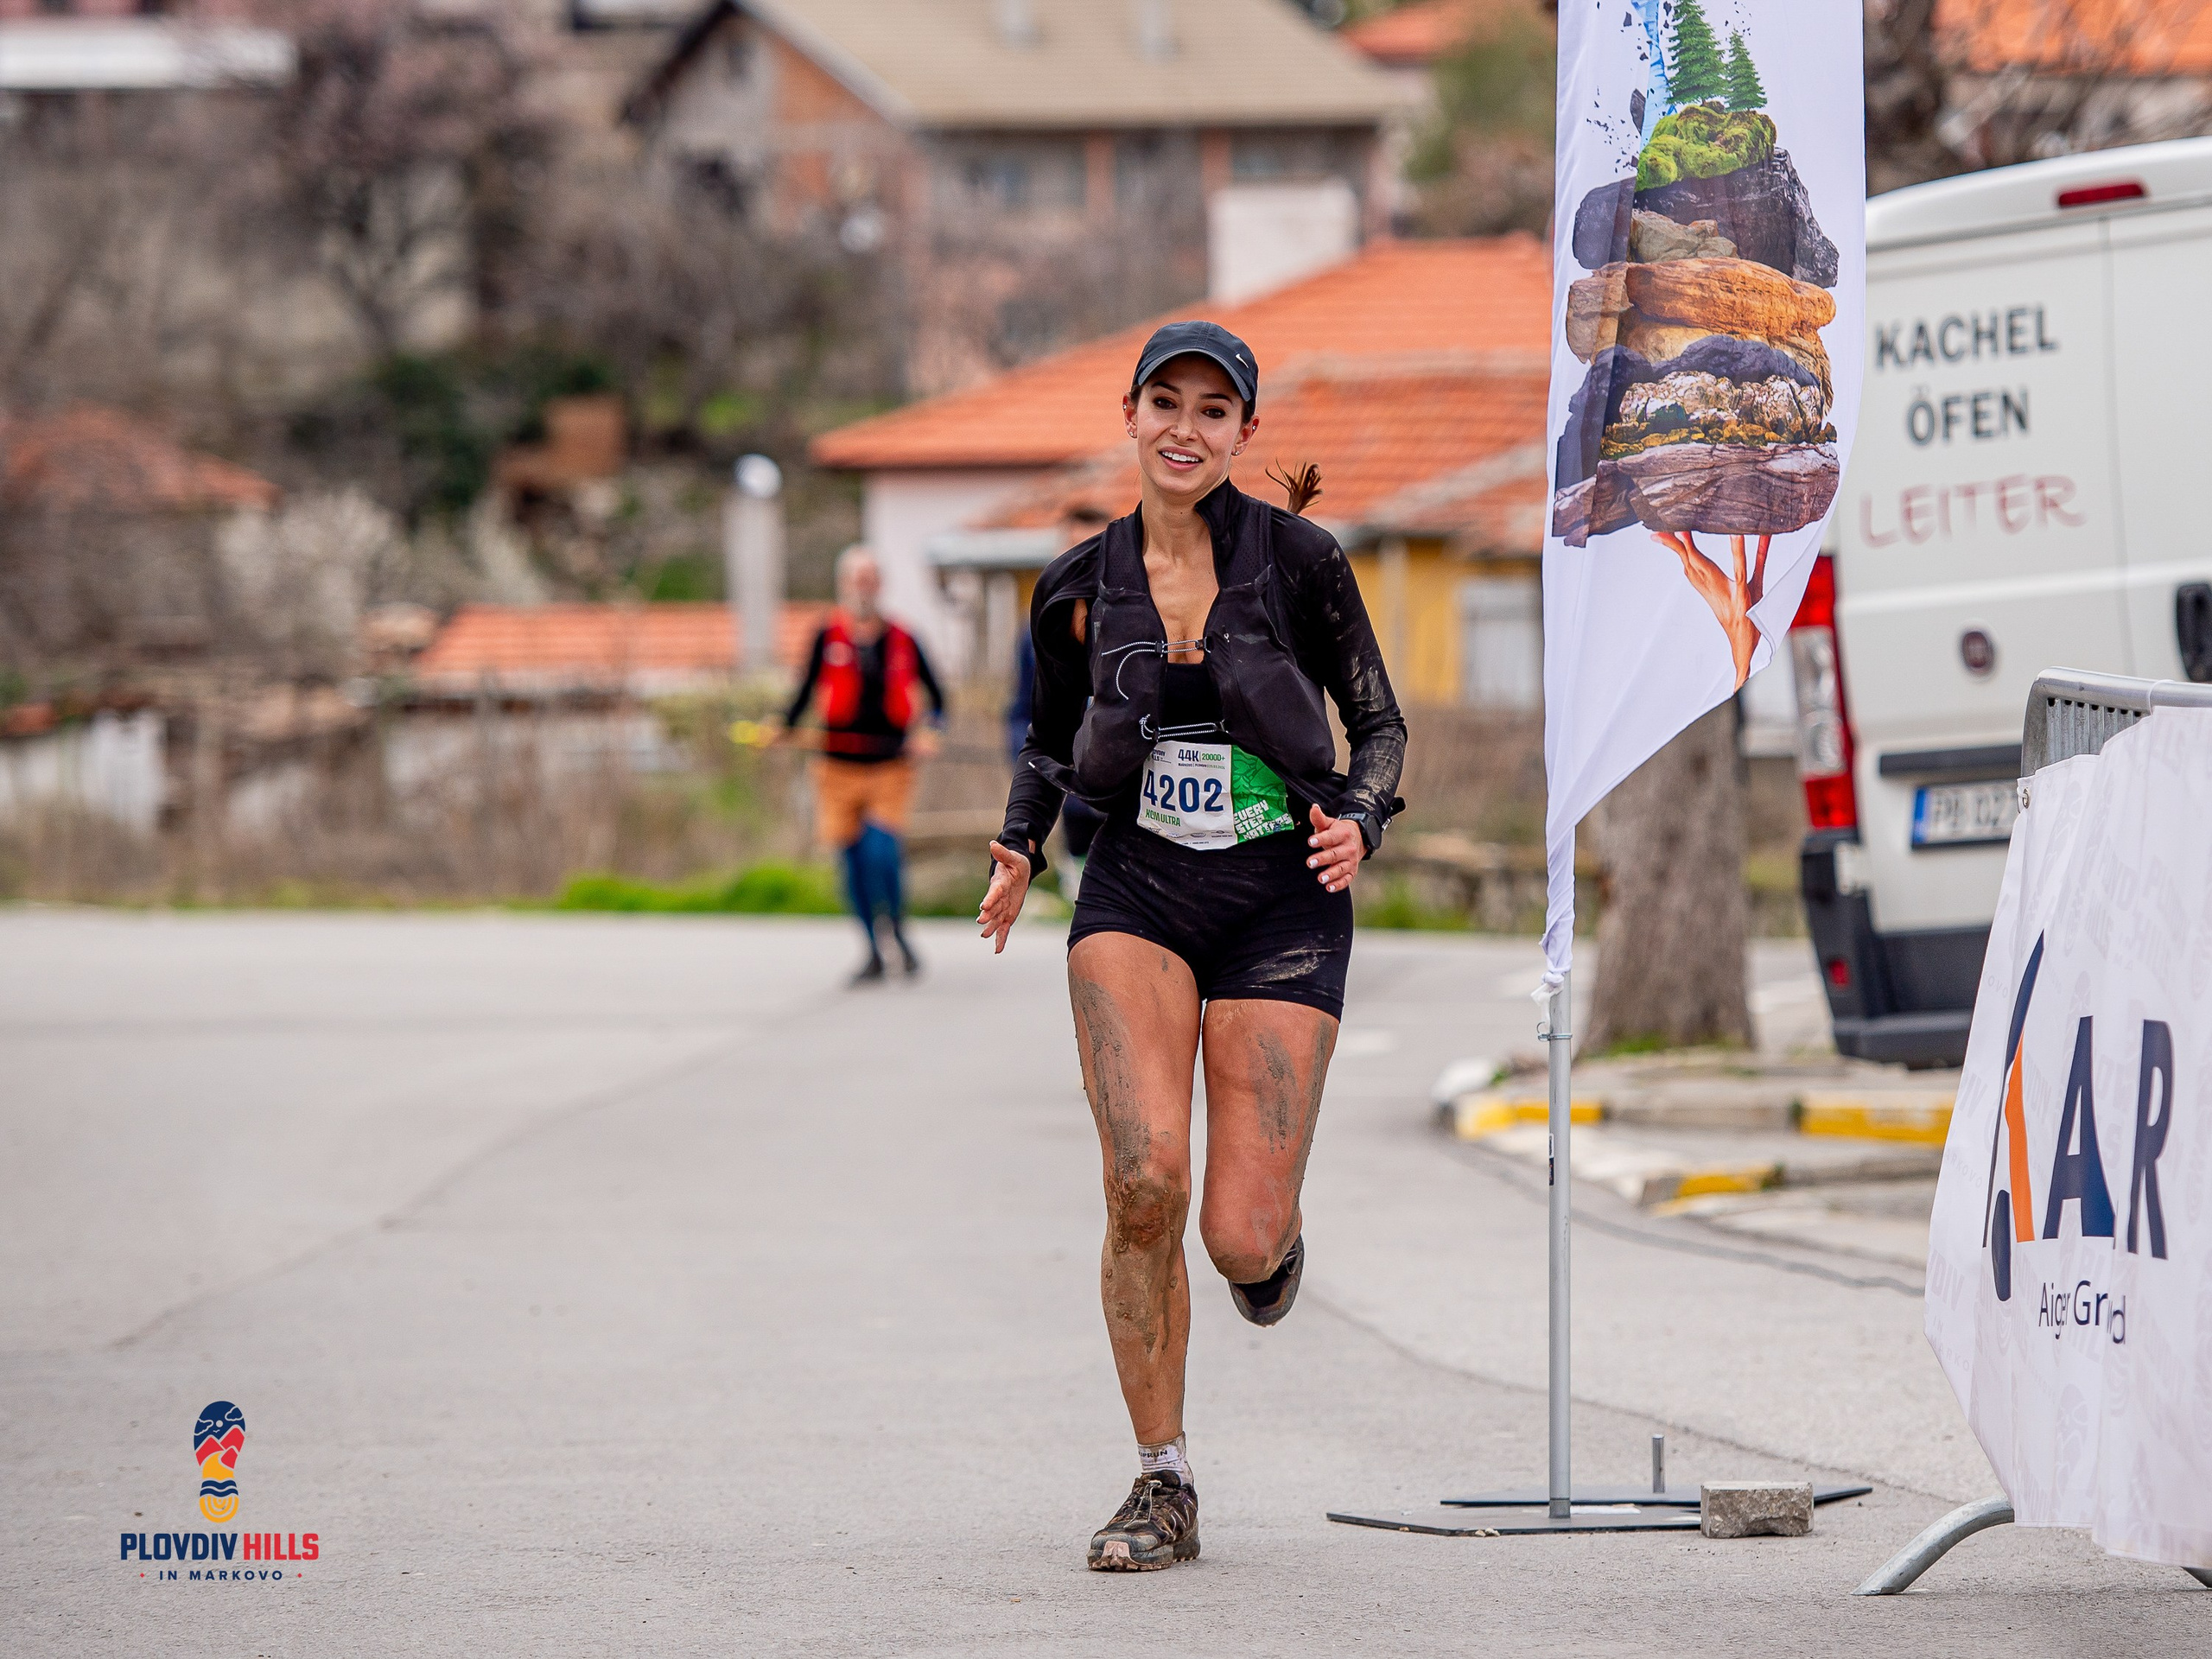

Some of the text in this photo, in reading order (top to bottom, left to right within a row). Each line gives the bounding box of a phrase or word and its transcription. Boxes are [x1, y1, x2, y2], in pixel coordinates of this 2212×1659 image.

[1875, 303, 2061, 371] KACHEL
[1907, 385, 2031, 448] ÖFEN
[1859, 474, 2087, 549] LEITER
[1178, 748, 1199, 762] 44K
[1143, 769, 1224, 813] 4202
[1160, 813, 1181, 827] ULTRA
[1233, 799, 1269, 825] EVERY
[1235, 814, 1265, 834] STEP
[1243, 813, 1294, 840] MATTERS
[2038, 1282, 2071, 1340] Aiger
